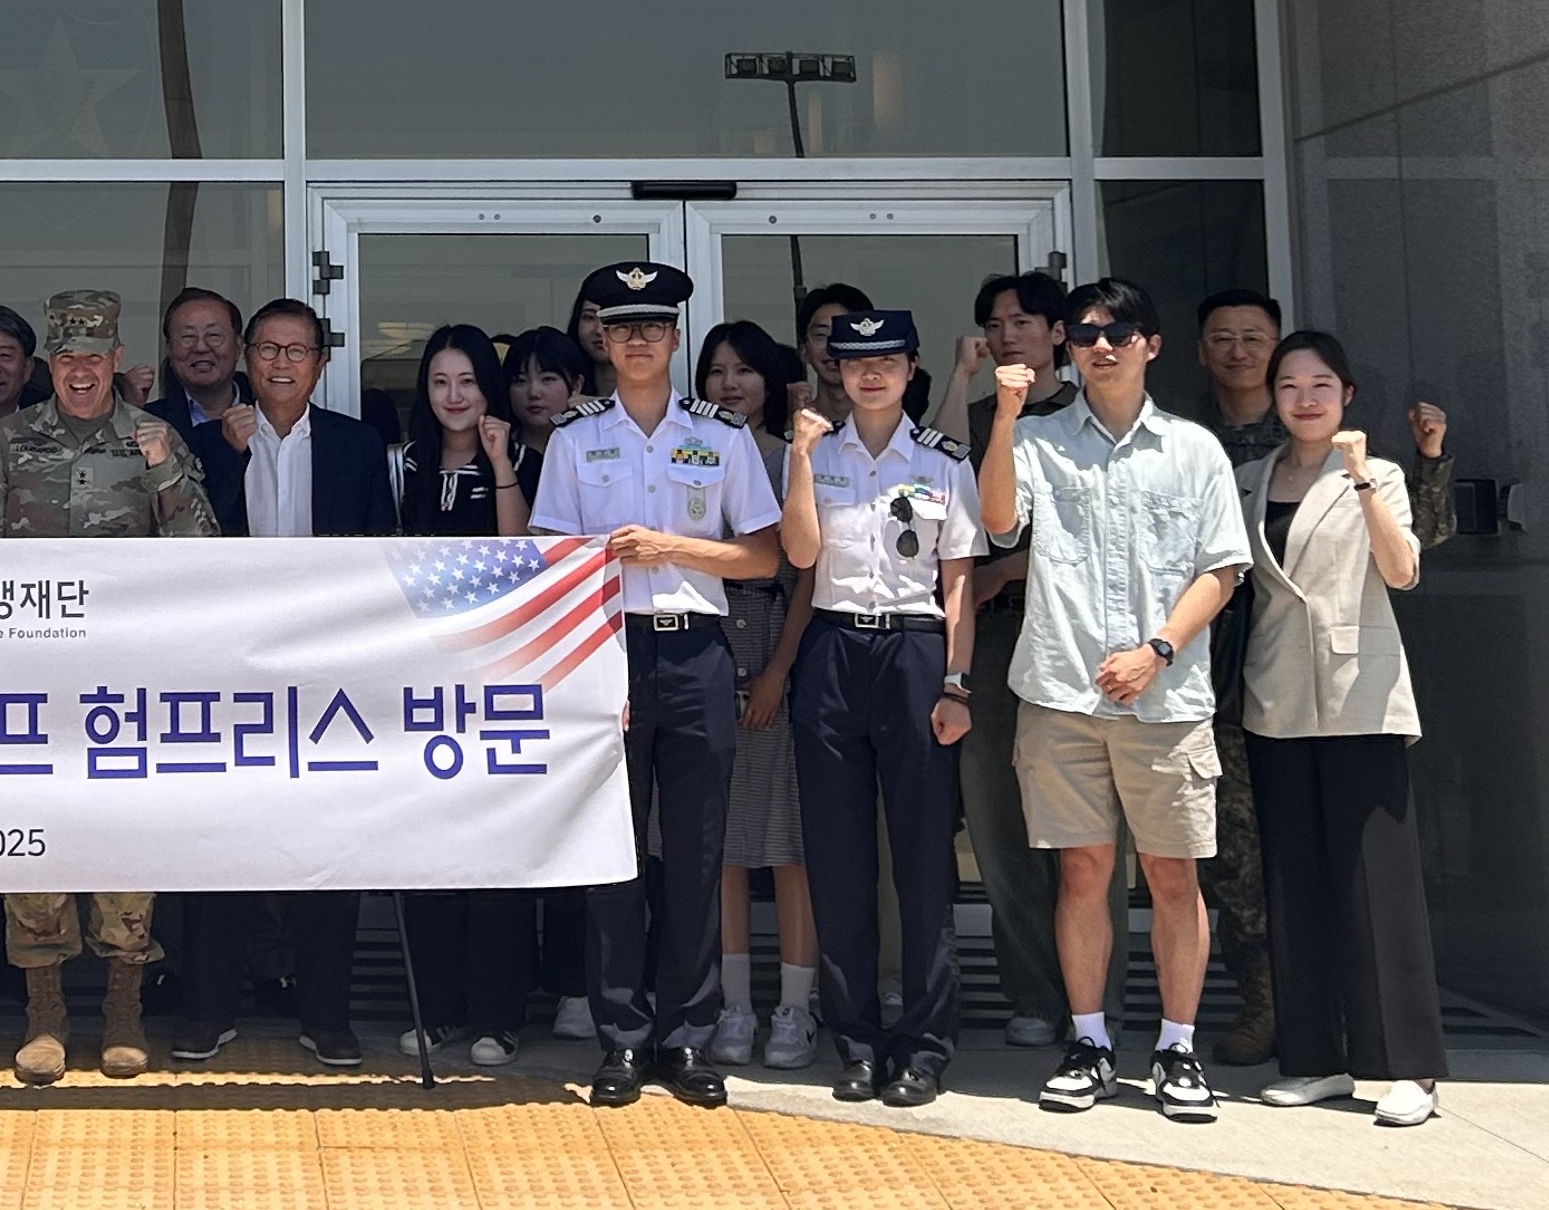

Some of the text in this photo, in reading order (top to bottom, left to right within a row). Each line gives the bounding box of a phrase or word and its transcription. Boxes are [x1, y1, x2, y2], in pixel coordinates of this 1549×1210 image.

[8, 627, 86, 640] Foundation
[79, 685, 379, 780] 험프리스
[403, 683, 551, 780] 방문
